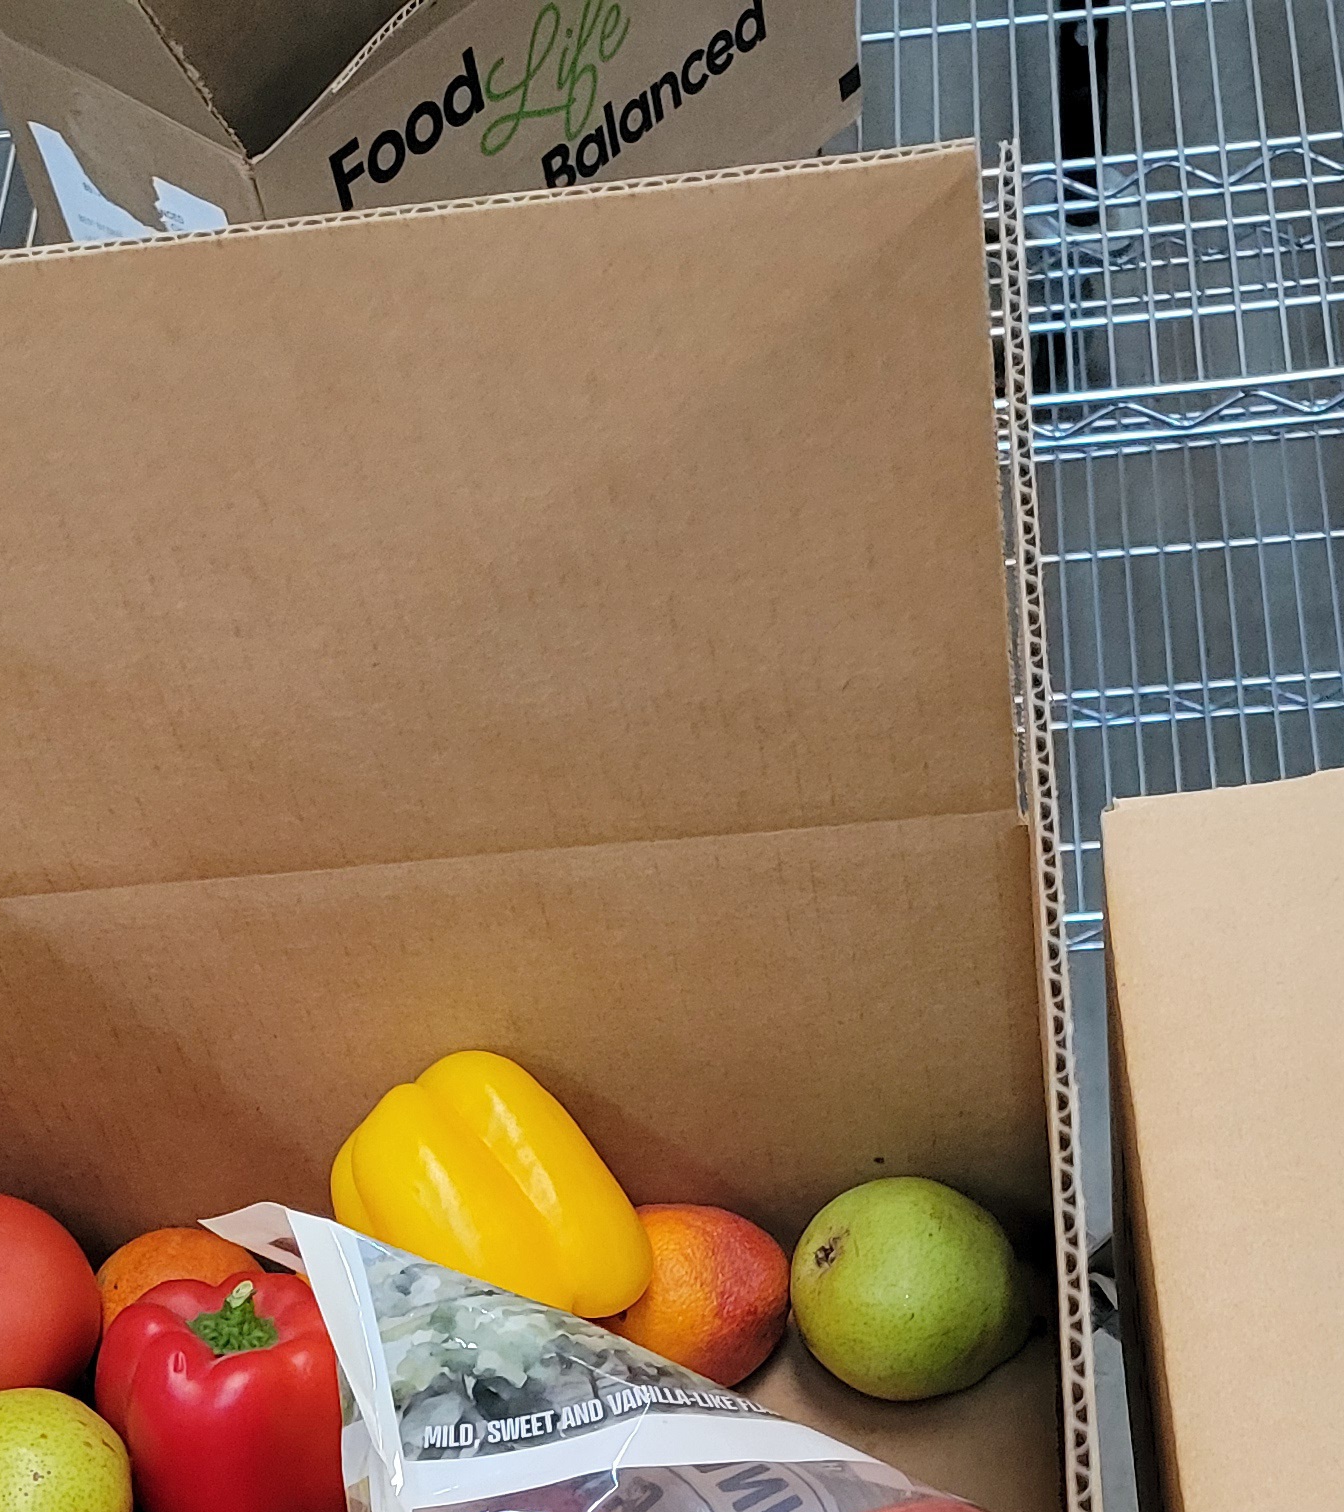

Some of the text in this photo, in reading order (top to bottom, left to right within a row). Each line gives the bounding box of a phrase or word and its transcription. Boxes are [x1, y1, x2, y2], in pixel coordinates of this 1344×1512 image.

[328, 0, 631, 211] Food Life
[541, 0, 768, 188] Balanced
[424, 1422, 481, 1449] MILD,
[487, 1409, 555, 1443] SWEET
[560, 1398, 604, 1430] AND
[607, 1384, 738, 1418] VANILLA-LIKE
